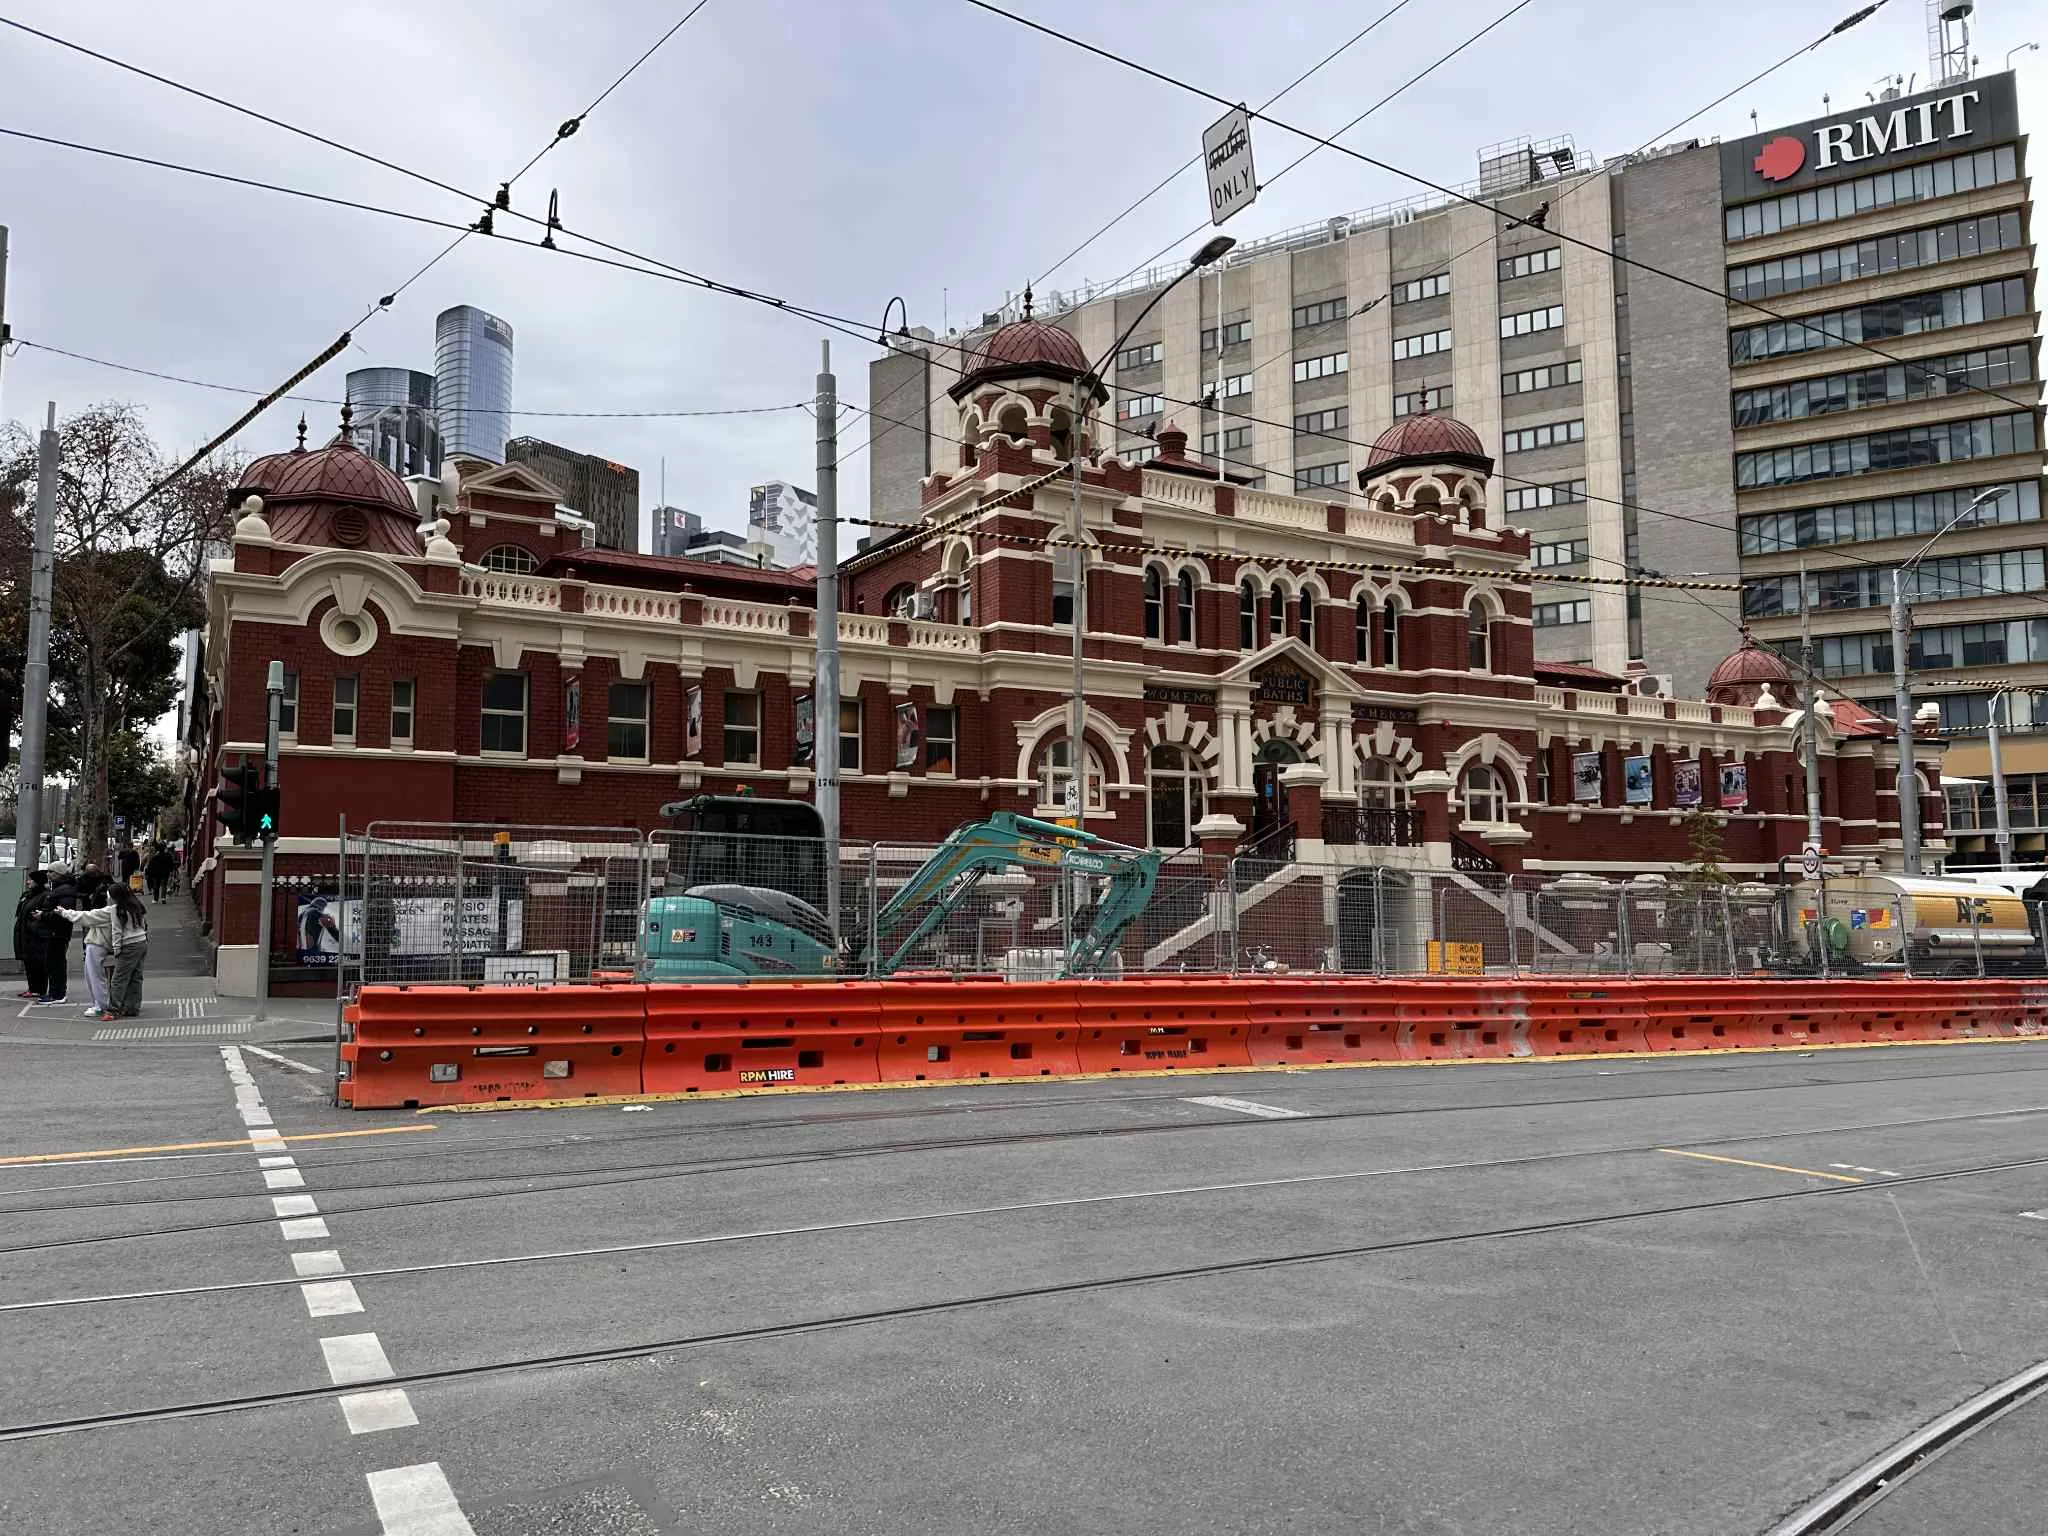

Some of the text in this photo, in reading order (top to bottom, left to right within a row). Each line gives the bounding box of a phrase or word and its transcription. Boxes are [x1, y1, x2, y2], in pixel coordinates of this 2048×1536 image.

[1812, 90, 1980, 171] RMIT
[1214, 166, 1249, 209] ONLY
[1261, 677, 1305, 690] PUBLIC
[1263, 688, 1304, 702] BATHS
[1069, 854, 1104, 870] KOBELCO
[443, 902, 486, 912] PHSIO
[443, 914, 489, 925] PIATES
[443, 926, 492, 937] MSSAG
[443, 939, 492, 951] PODIATR
[750, 935, 774, 948] 143
[1459, 944, 1479, 954] ROAD
[740, 1069, 794, 1082] RPM HIRE
